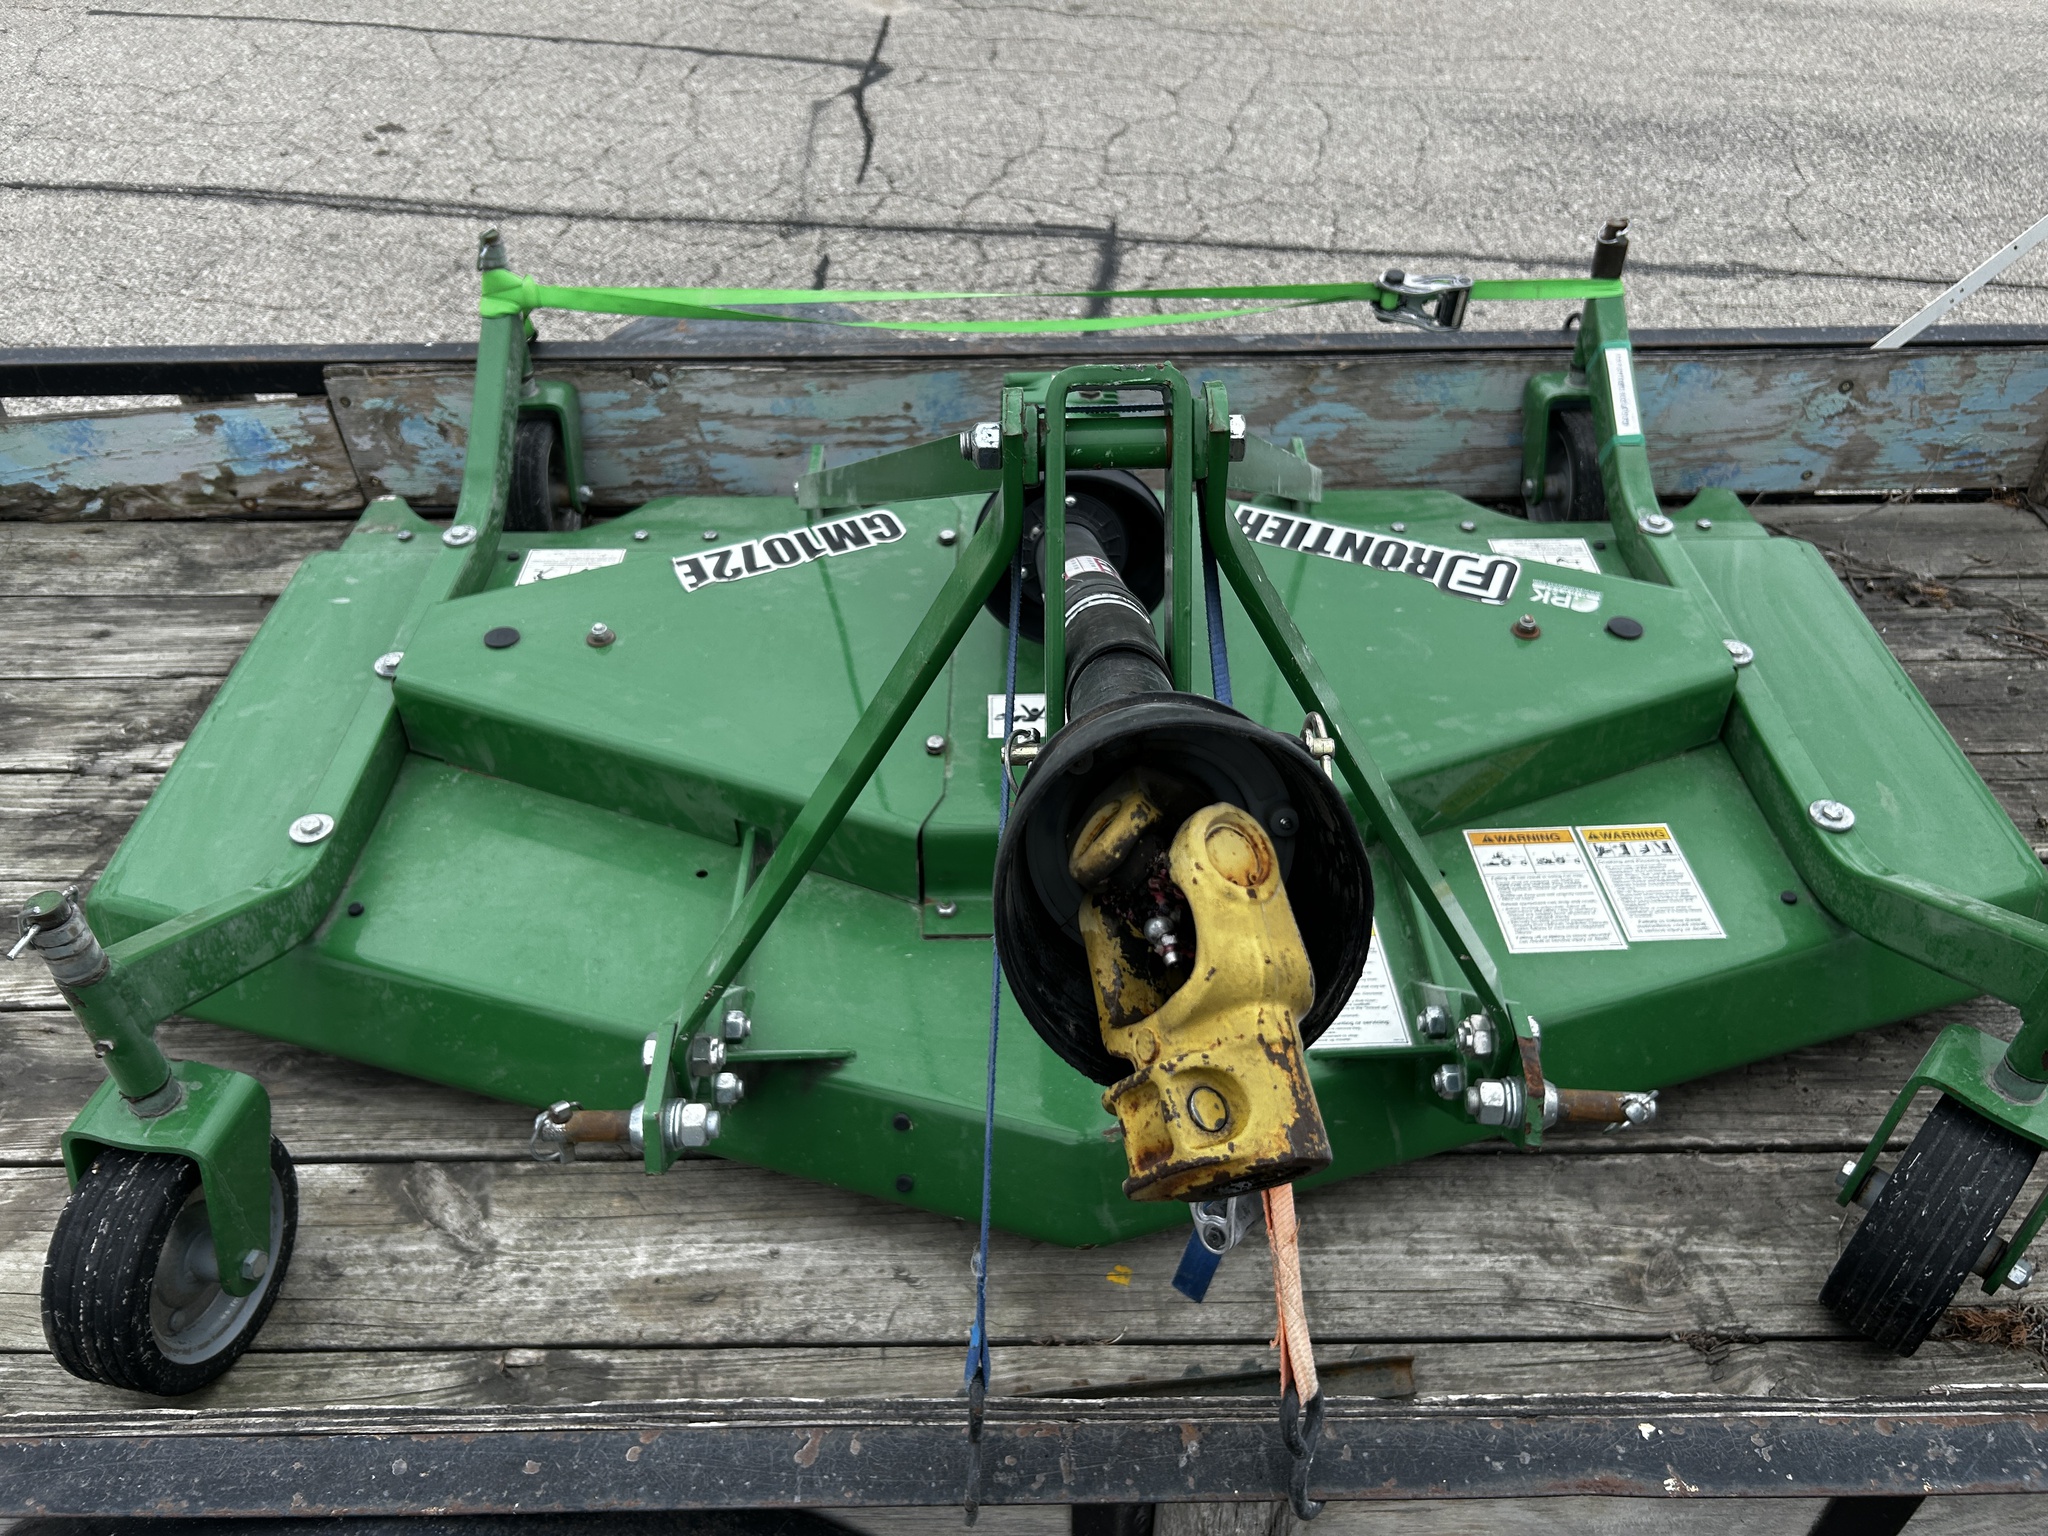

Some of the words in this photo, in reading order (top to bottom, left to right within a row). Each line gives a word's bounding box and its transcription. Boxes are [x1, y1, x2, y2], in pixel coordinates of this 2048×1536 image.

[675, 512, 904, 589] GM1072E
[1236, 508, 1519, 604] FRONTIER
[1494, 832, 1562, 843] WARNING
[1599, 829, 1666, 841] WARNING
